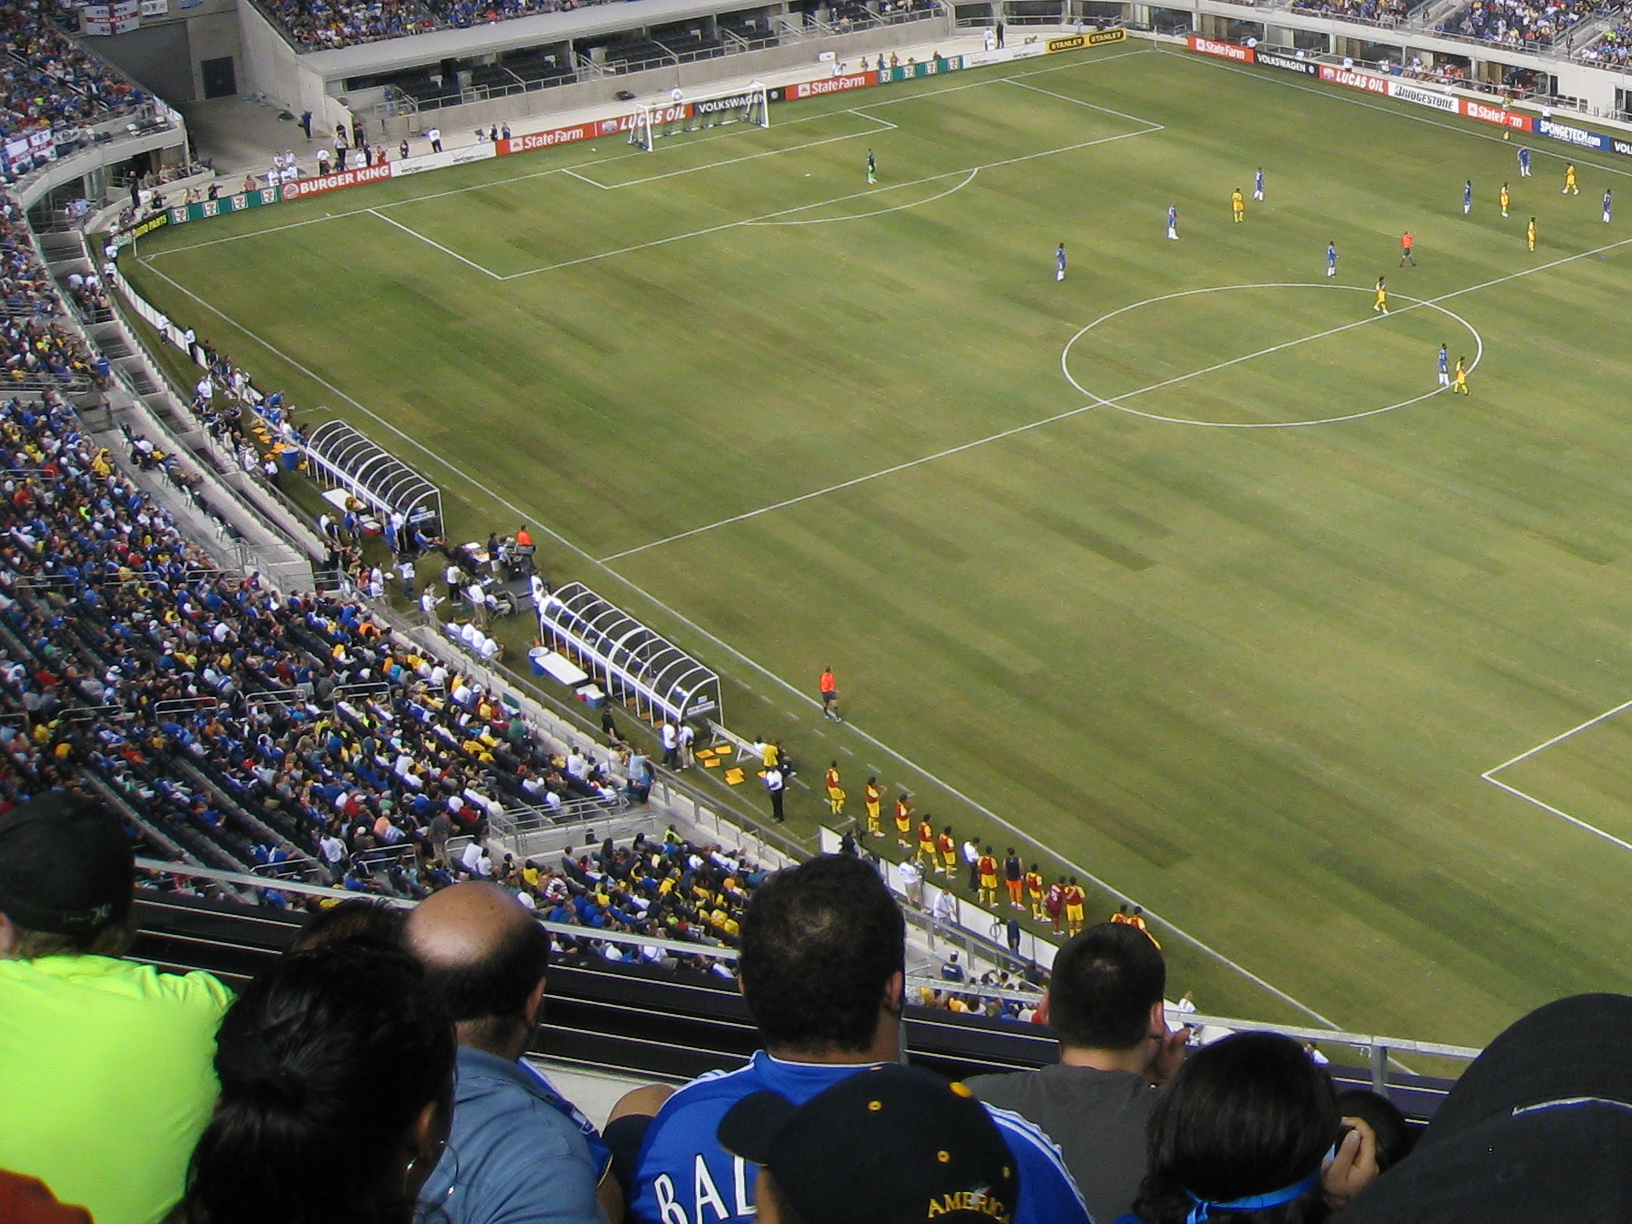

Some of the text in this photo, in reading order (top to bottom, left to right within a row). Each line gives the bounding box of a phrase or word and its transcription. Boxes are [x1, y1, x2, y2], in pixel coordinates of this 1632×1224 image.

[96, 7, 128, 15] ATLNTA
[1051, 37, 1082, 50] STANLEY
[1091, 32, 1121, 43] STANLEY
[1256, 53, 1306, 73] VOLKSWAGEN
[1335, 70, 1385, 93] LUCAS OIL
[1393, 84, 1454, 110] BRIDGESTONE
[666, 105, 687, 122] OIL
[300, 166, 389, 194] BURGER KING
